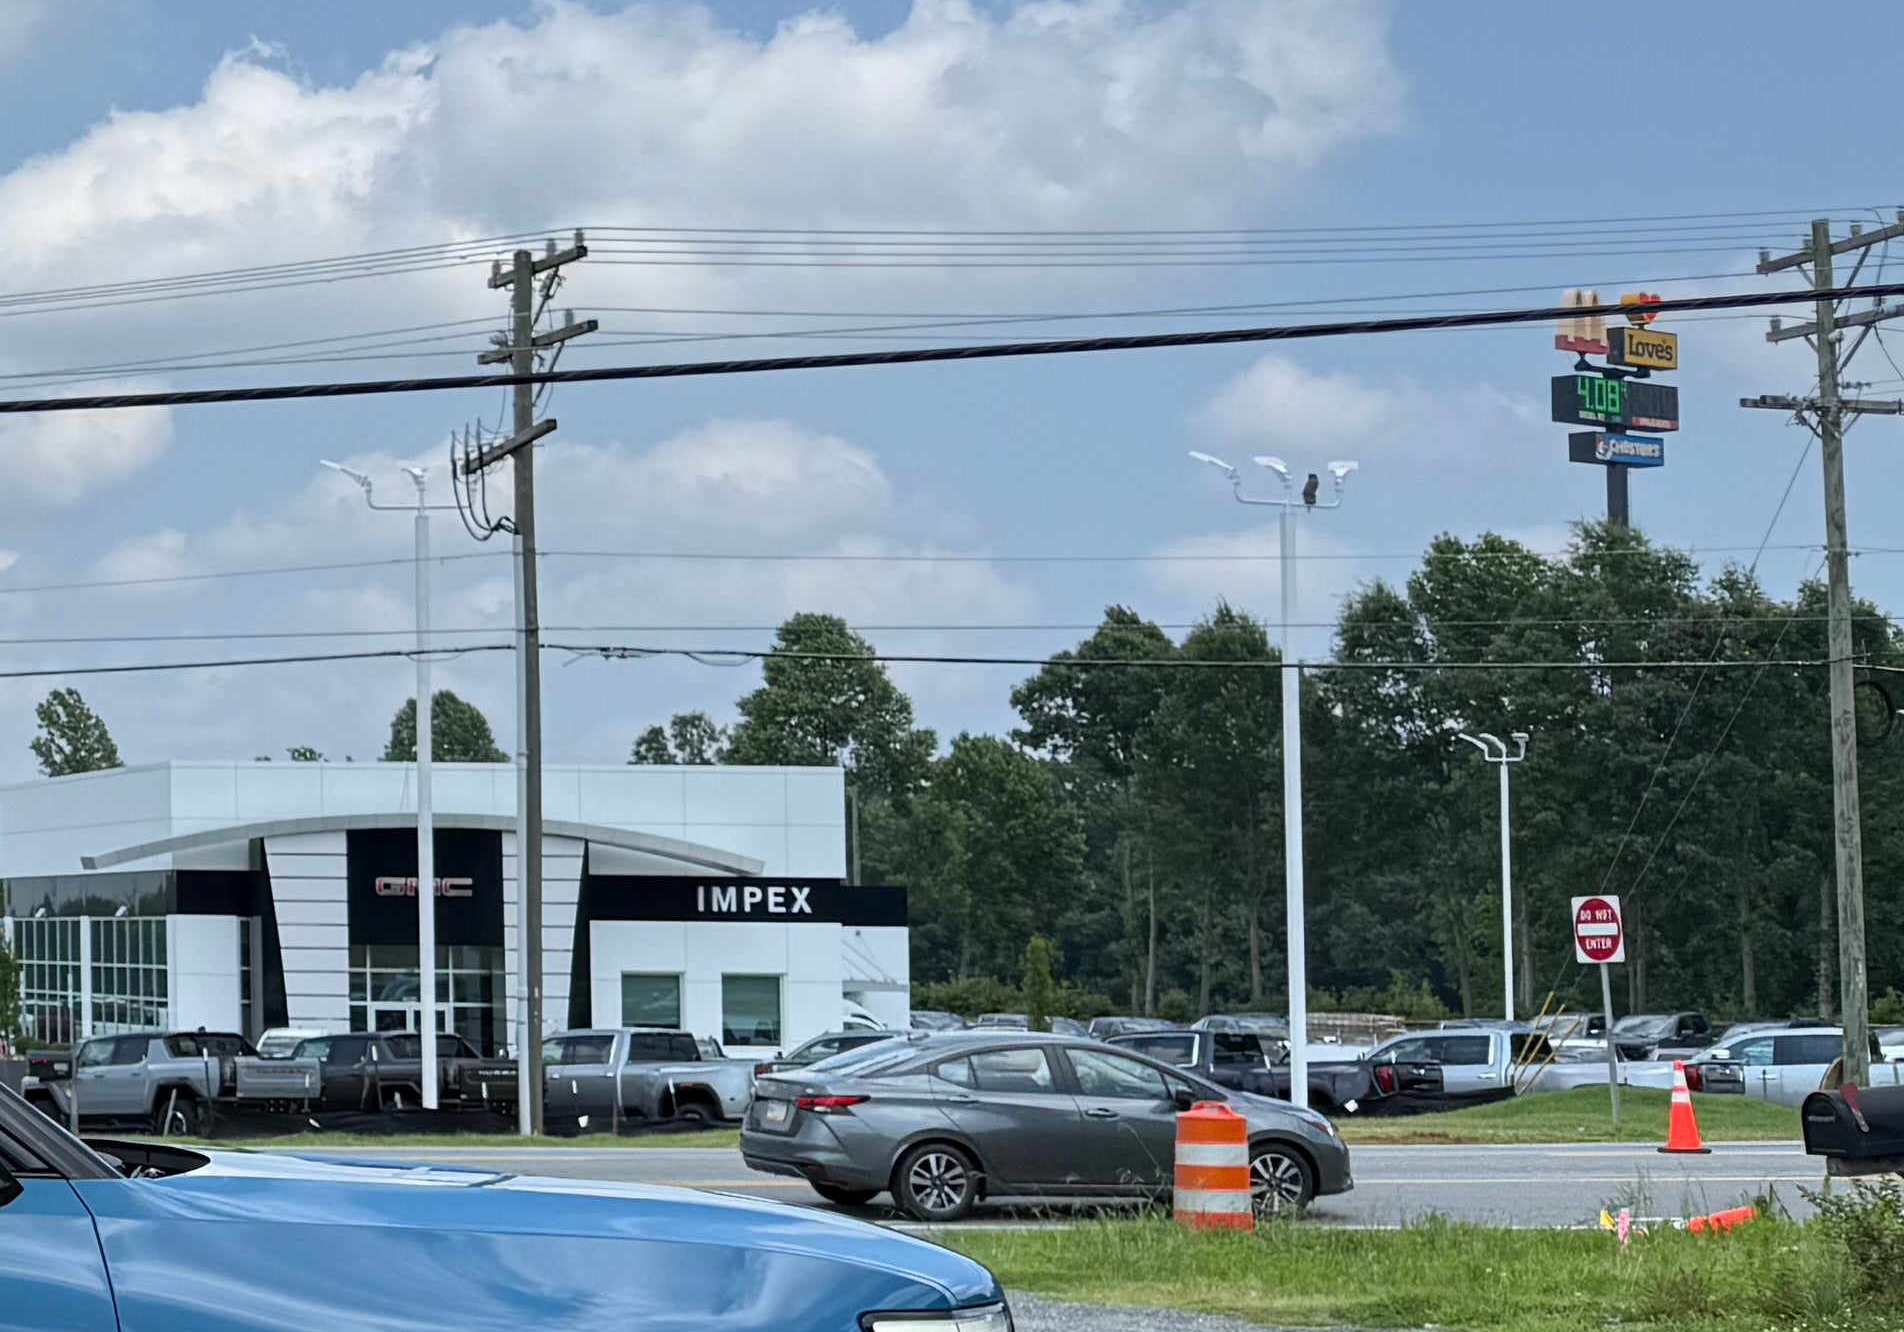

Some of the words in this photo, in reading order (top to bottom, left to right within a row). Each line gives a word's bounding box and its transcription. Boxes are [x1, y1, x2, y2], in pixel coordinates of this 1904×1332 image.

[1628, 334, 1674, 361] Love's
[696, 885, 813, 914] IMPEX
[1579, 909, 1592, 921] DO
[1595, 908, 1612, 921] NOT
[1585, 937, 1612, 950] ENTER
